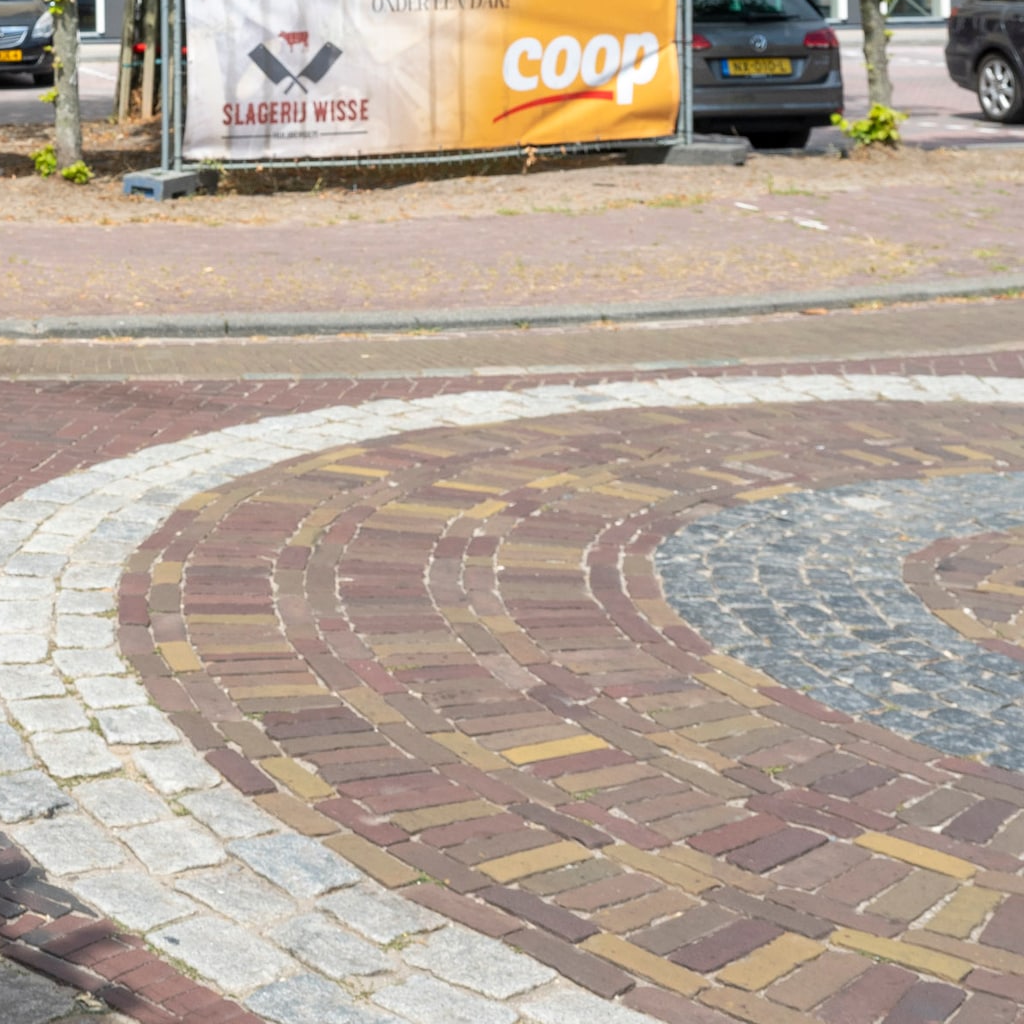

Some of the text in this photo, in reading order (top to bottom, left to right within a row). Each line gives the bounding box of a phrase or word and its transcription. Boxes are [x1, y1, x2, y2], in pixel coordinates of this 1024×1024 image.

[502, 31, 659, 105] coop
[222, 99, 370, 126] SLAGERIJ WISSE
